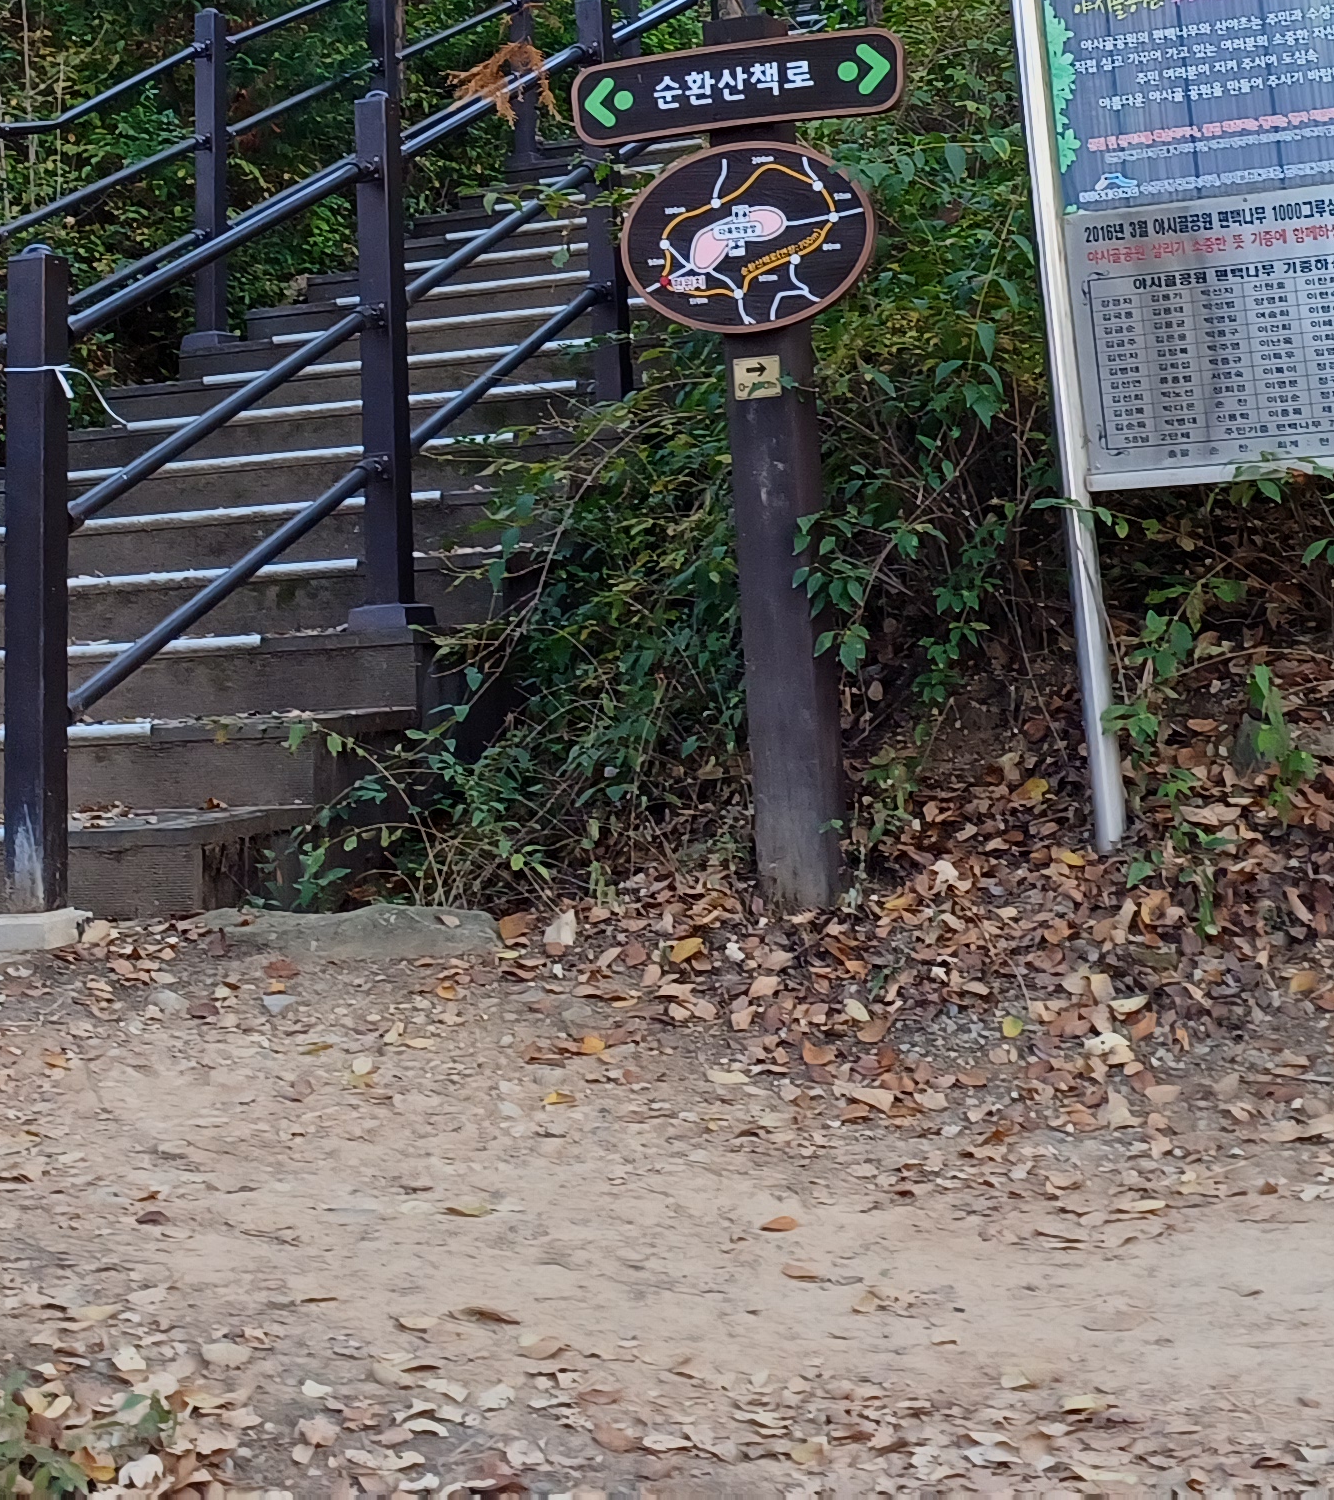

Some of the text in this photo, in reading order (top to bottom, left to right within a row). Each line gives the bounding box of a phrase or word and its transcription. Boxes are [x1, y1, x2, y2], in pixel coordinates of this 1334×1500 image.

[1080, 30, 1151, 52] 야시골공원의
[1151, 22, 1212, 44] 편백나무와
[1213, 15, 1263, 35] 산야초는
[1264, 8, 1303, 26] 주민과
[1073, 58, 1098, 77] 직접
[1099, 55, 1125, 71] 심고
[1126, 49, 1163, 67] 가꾸어
[1165, 46, 1191, 60] 가고
[1192, 42, 1218, 59] 있는
[1220, 34, 1269, 52] 여러분의
[1271, 26, 1311, 46] 소중한
[1134, 48, 1320, 85] 주민 여러분이 지켜 주시어 도심속
[653, 60, 814, 110] 순환산책로
[1098, 92, 1147, 111] 아름다운
[1148, 87, 1185, 103] 야시골
[1186, 81, 1225, 101] 공원을
[1226, 76, 1264, 95] 만들어
[1266, 71, 1304, 88] 주시기
[1083, 222, 1126, 244] 2016년
[1128, 219, 1149, 239] 3월
[1152, 212, 1214, 236] 야시골공원
[1217, 206, 1267, 229] 편백나무
[1086, 244, 1147, 266] 야시골공원
[1150, 240, 1186, 259] 살리기
[1191, 235, 1228, 254] 소중한
[1232, 233, 1245, 250] 뜻
[1250, 228, 1288, 248] 기증에
[1132, 270, 1208, 290] 야시골공원
[1214, 263, 1276, 282] 편백나무
